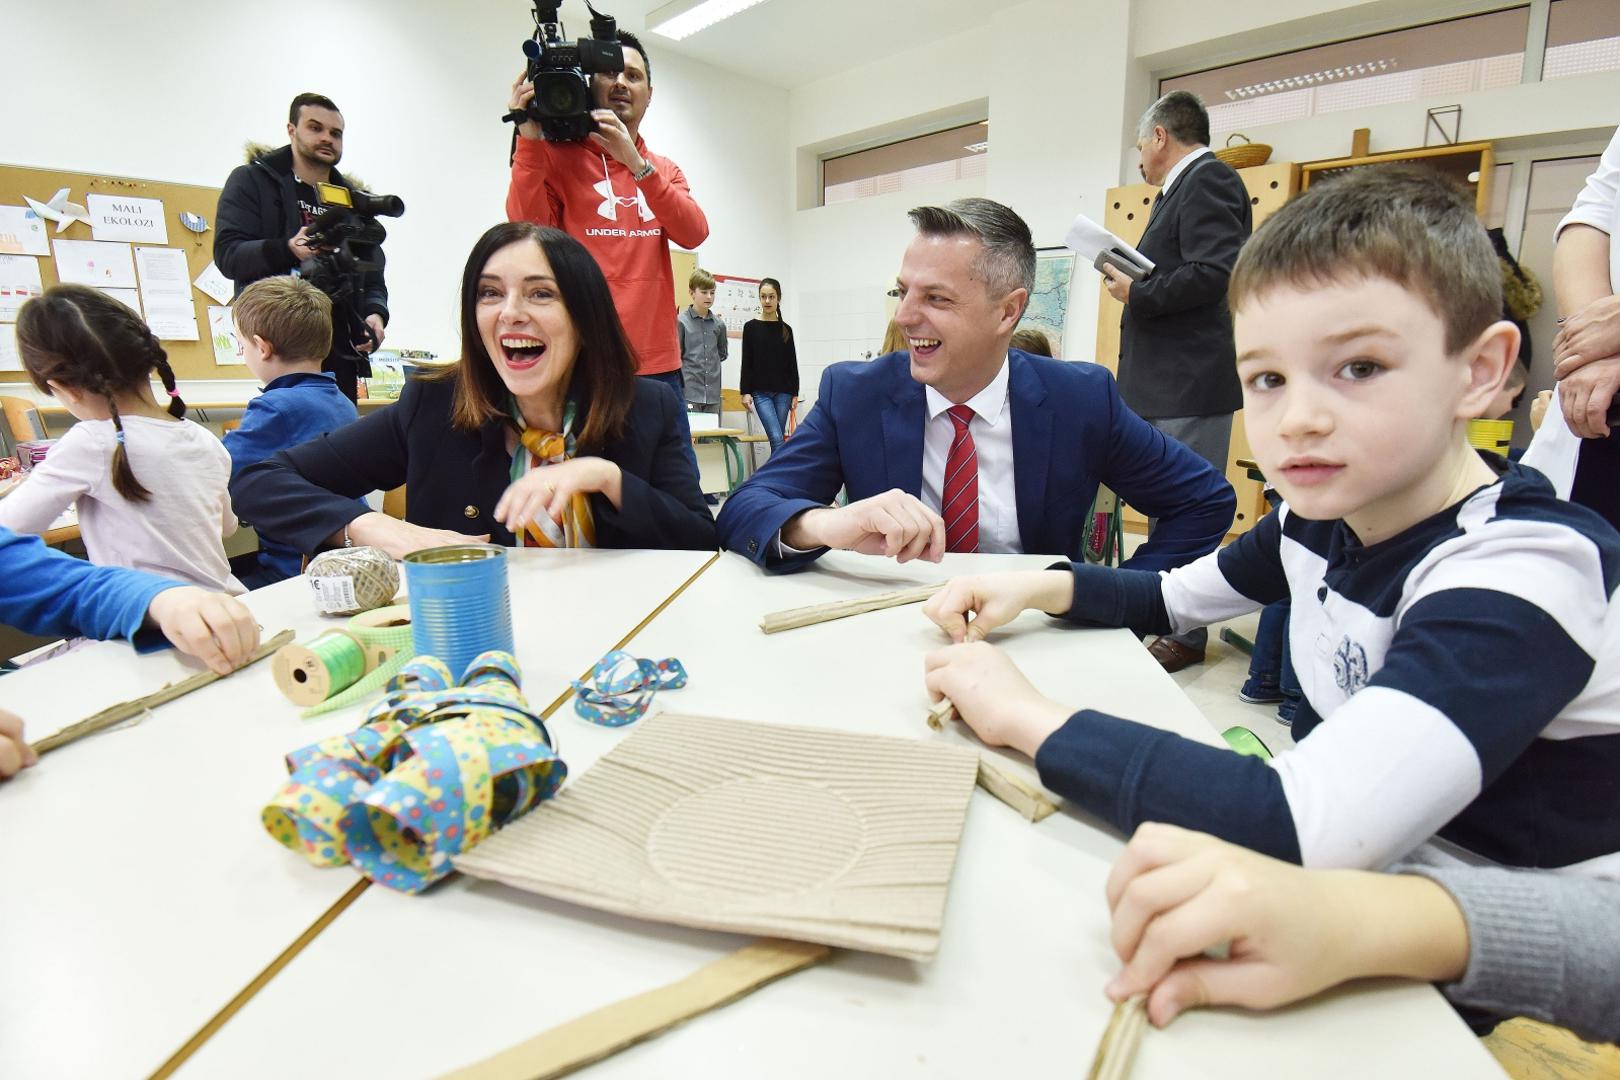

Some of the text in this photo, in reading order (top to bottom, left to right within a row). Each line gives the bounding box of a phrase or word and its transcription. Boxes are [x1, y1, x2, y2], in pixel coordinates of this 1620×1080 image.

[112, 203, 142, 215] MALI
[103, 216, 154, 228] EKOLOZI
[585, 228, 627, 237] UNDER
